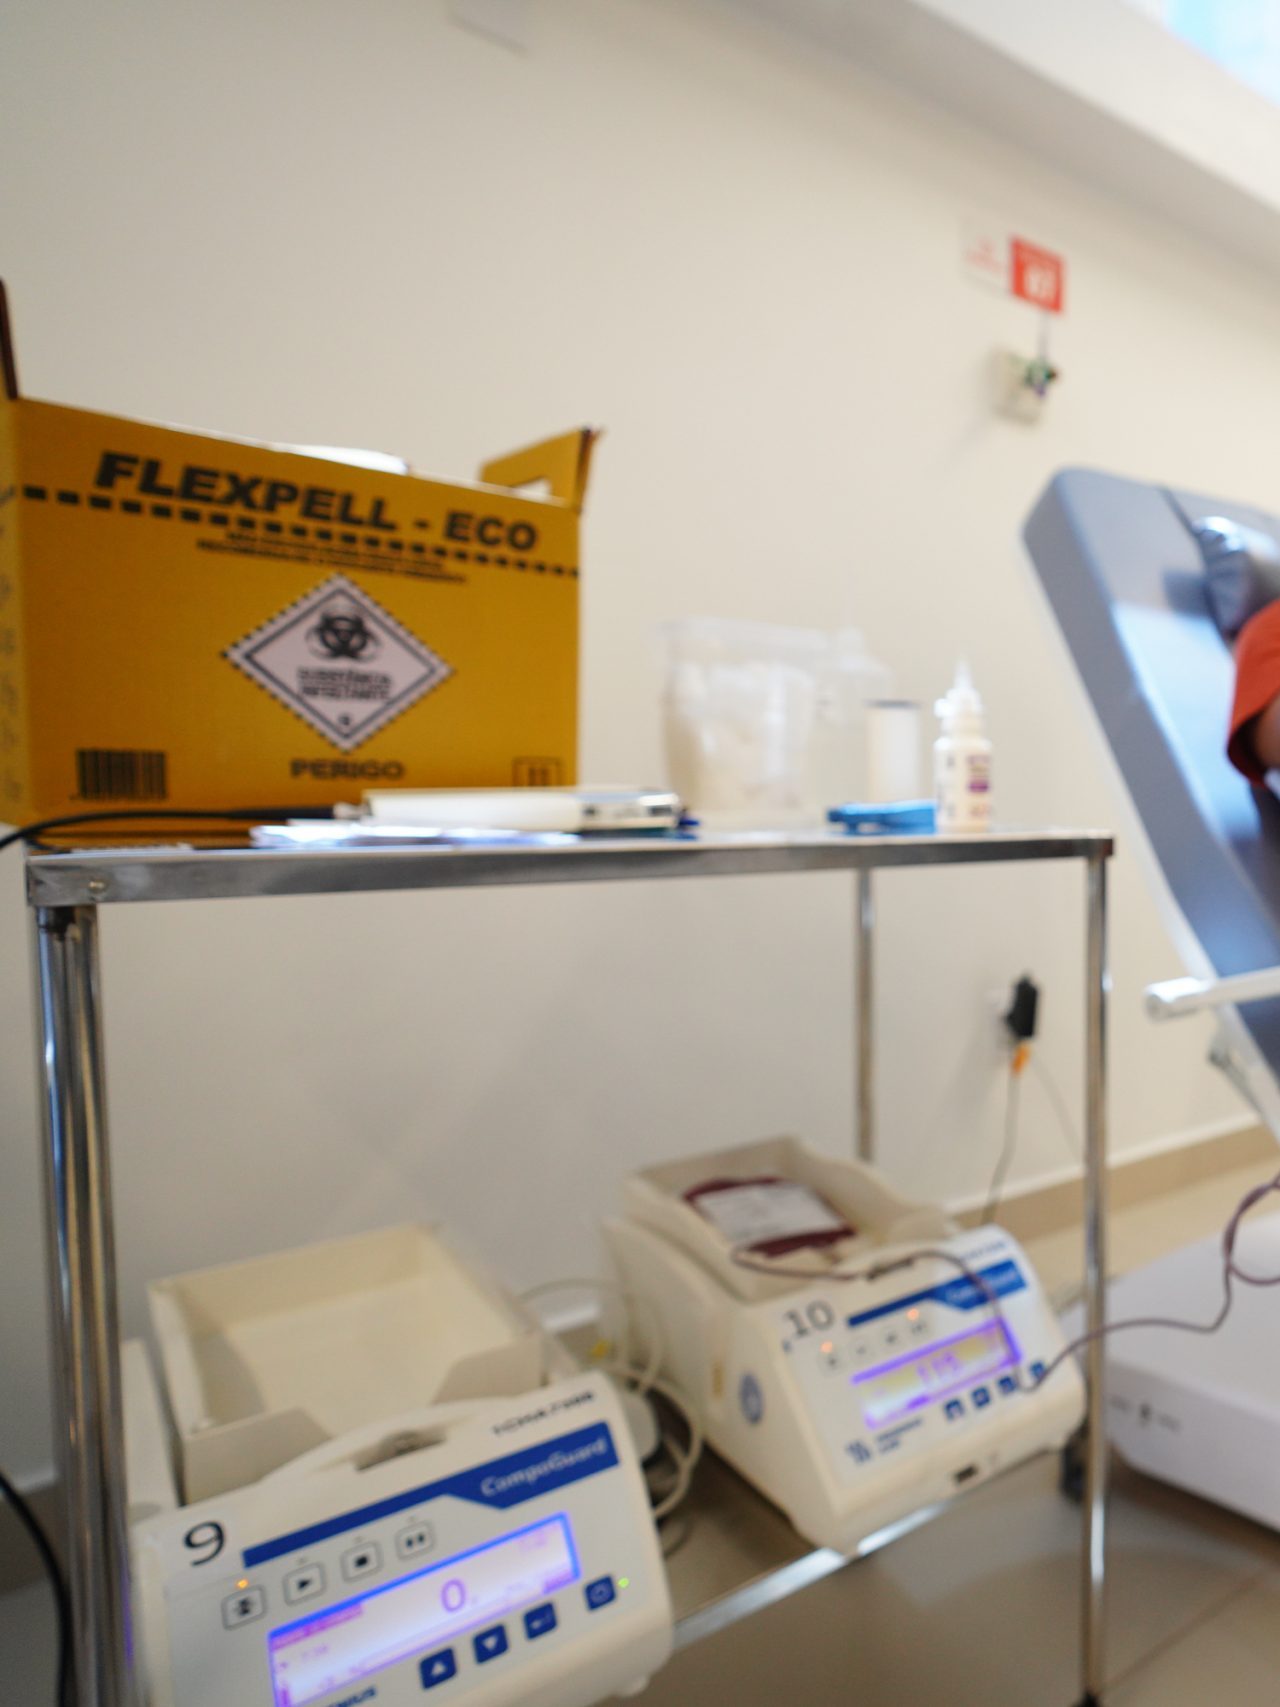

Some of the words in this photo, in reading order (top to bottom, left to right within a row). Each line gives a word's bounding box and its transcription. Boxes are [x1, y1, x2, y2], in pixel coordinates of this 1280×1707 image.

[94, 451, 397, 532] FLEXPELL
[443, 510, 538, 552] ECO
[290, 757, 405, 782] PERIGO
[782, 1299, 836, 1339] 10
[480, 1436, 608, 1498] CompoGuard
[183, 1521, 226, 1567] 9
[441, 1578, 467, 1612] 0
